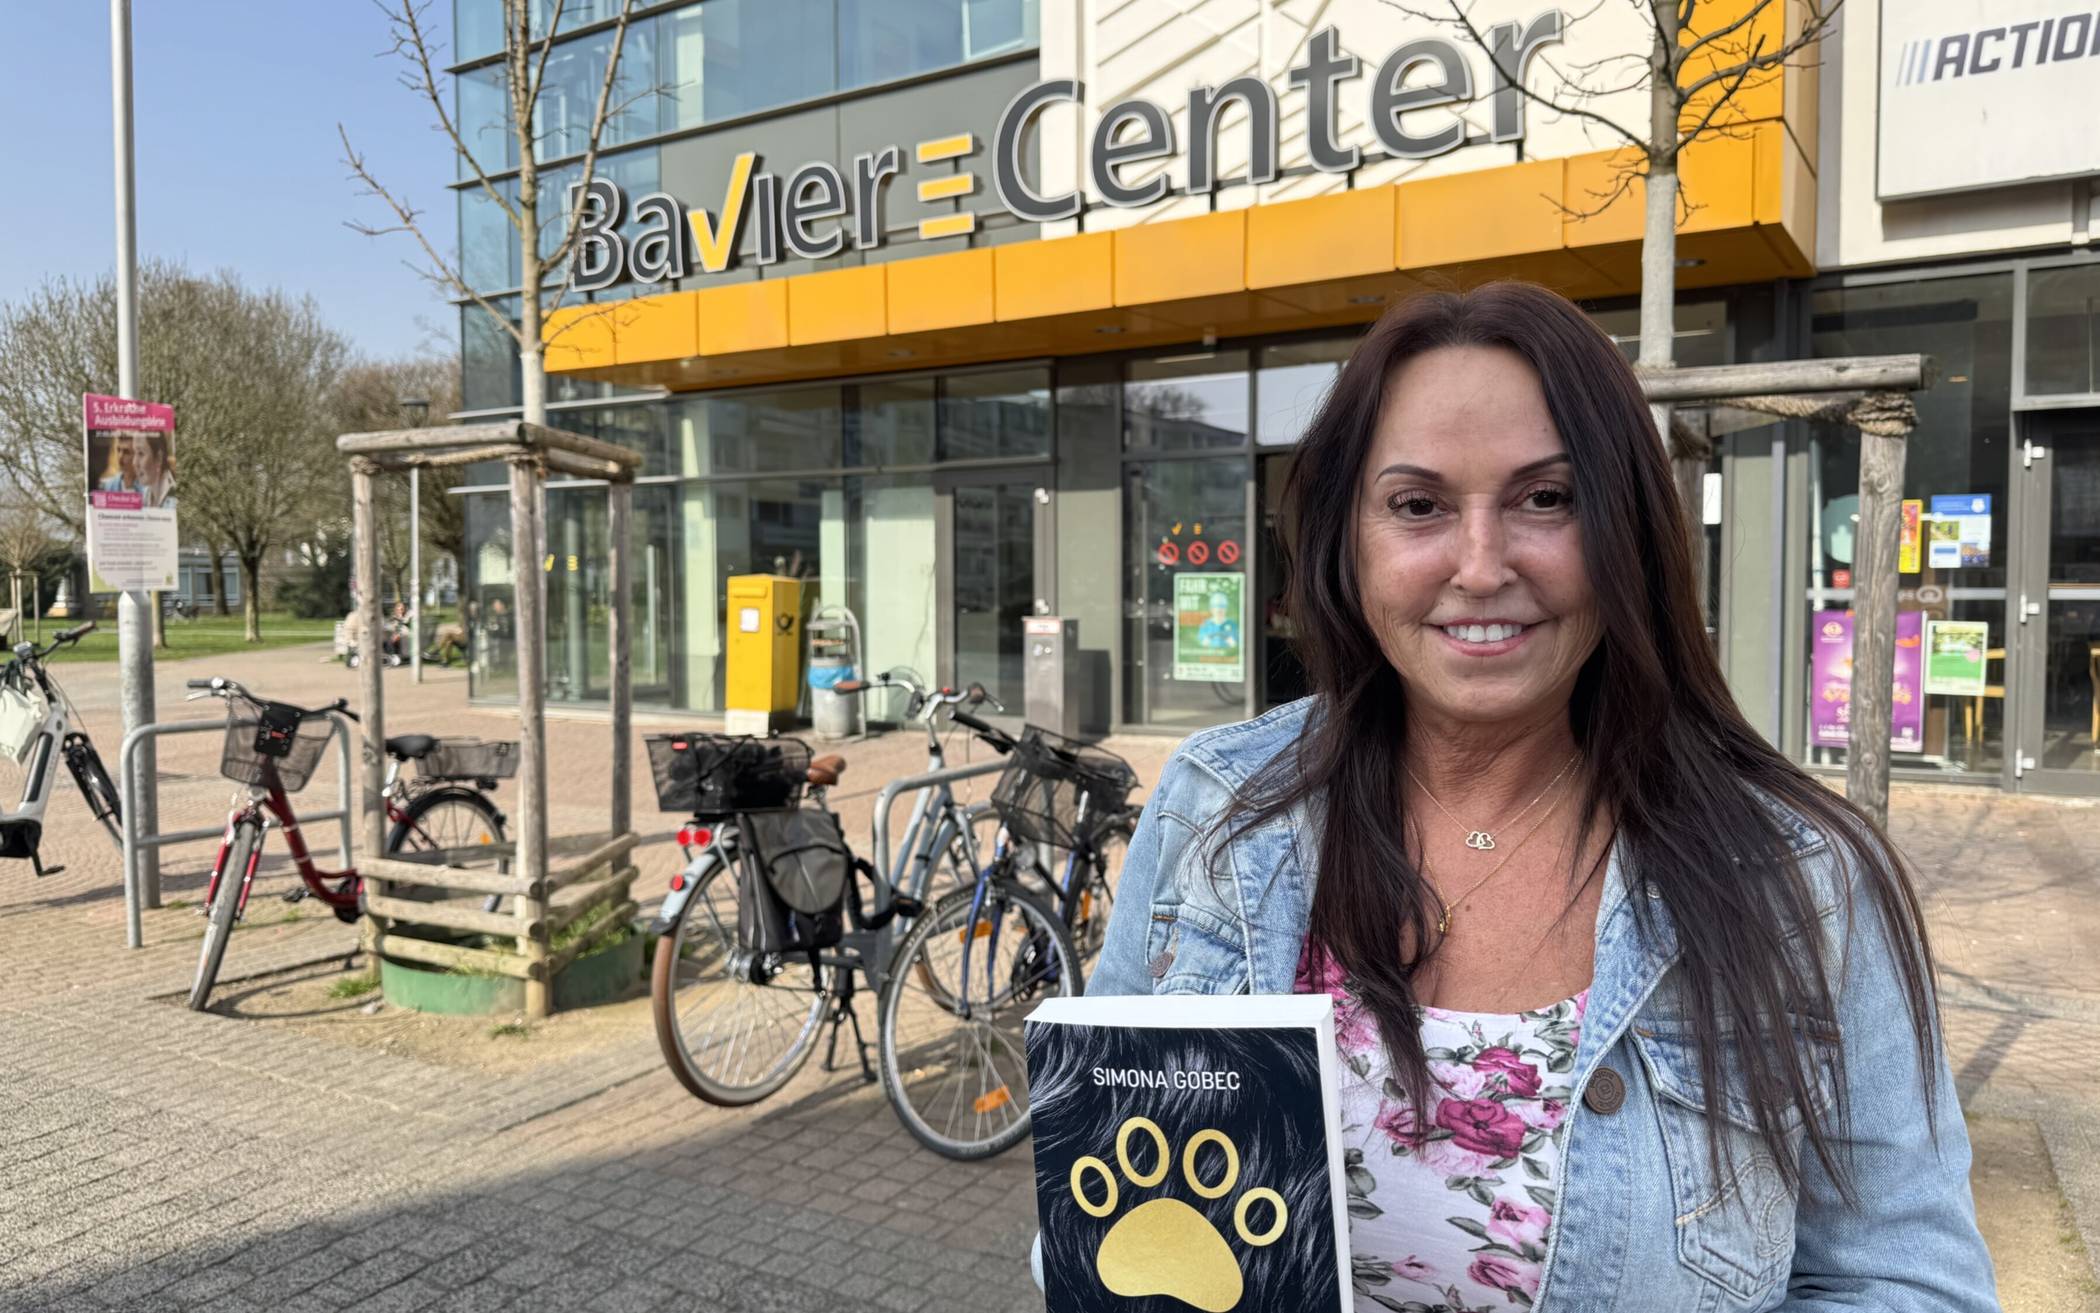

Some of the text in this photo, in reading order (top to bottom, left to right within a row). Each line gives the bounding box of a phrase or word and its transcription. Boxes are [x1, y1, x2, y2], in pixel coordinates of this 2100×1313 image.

[1932, 12, 2100, 81] ACTIO
[993, 8, 1563, 221] Center
[1093, 1067, 1241, 1091] SIMONA GOBEC
